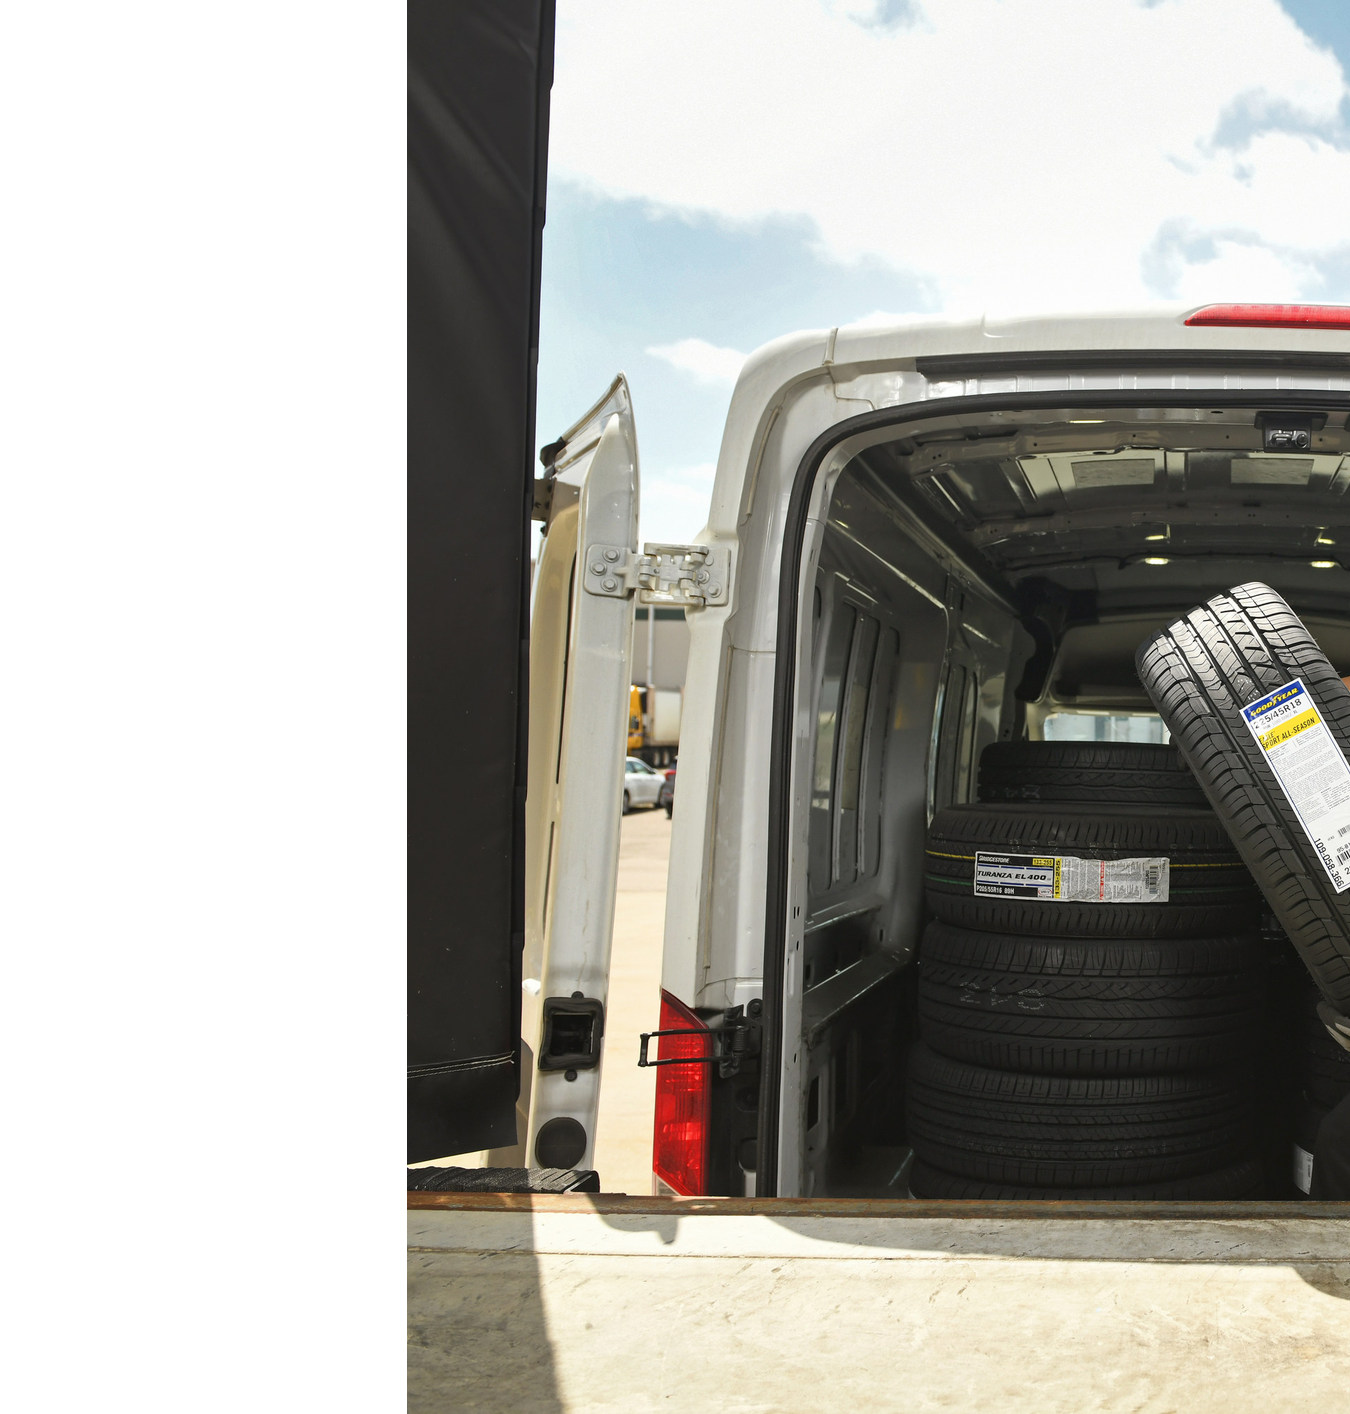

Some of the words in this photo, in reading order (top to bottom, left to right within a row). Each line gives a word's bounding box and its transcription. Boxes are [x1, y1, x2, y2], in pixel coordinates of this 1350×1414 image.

[1250, 687, 1299, 717] GOODYEAR
[1253, 698, 1302, 729] 225/45R18
[1262, 736, 1280, 749] SPORT
[1281, 717, 1316, 740] ALL-SEASON
[977, 870, 1013, 879] TURANZA
[979, 855, 1010, 864] BRIDGESTONE
[1314, 838, 1344, 887] 109-058-366
